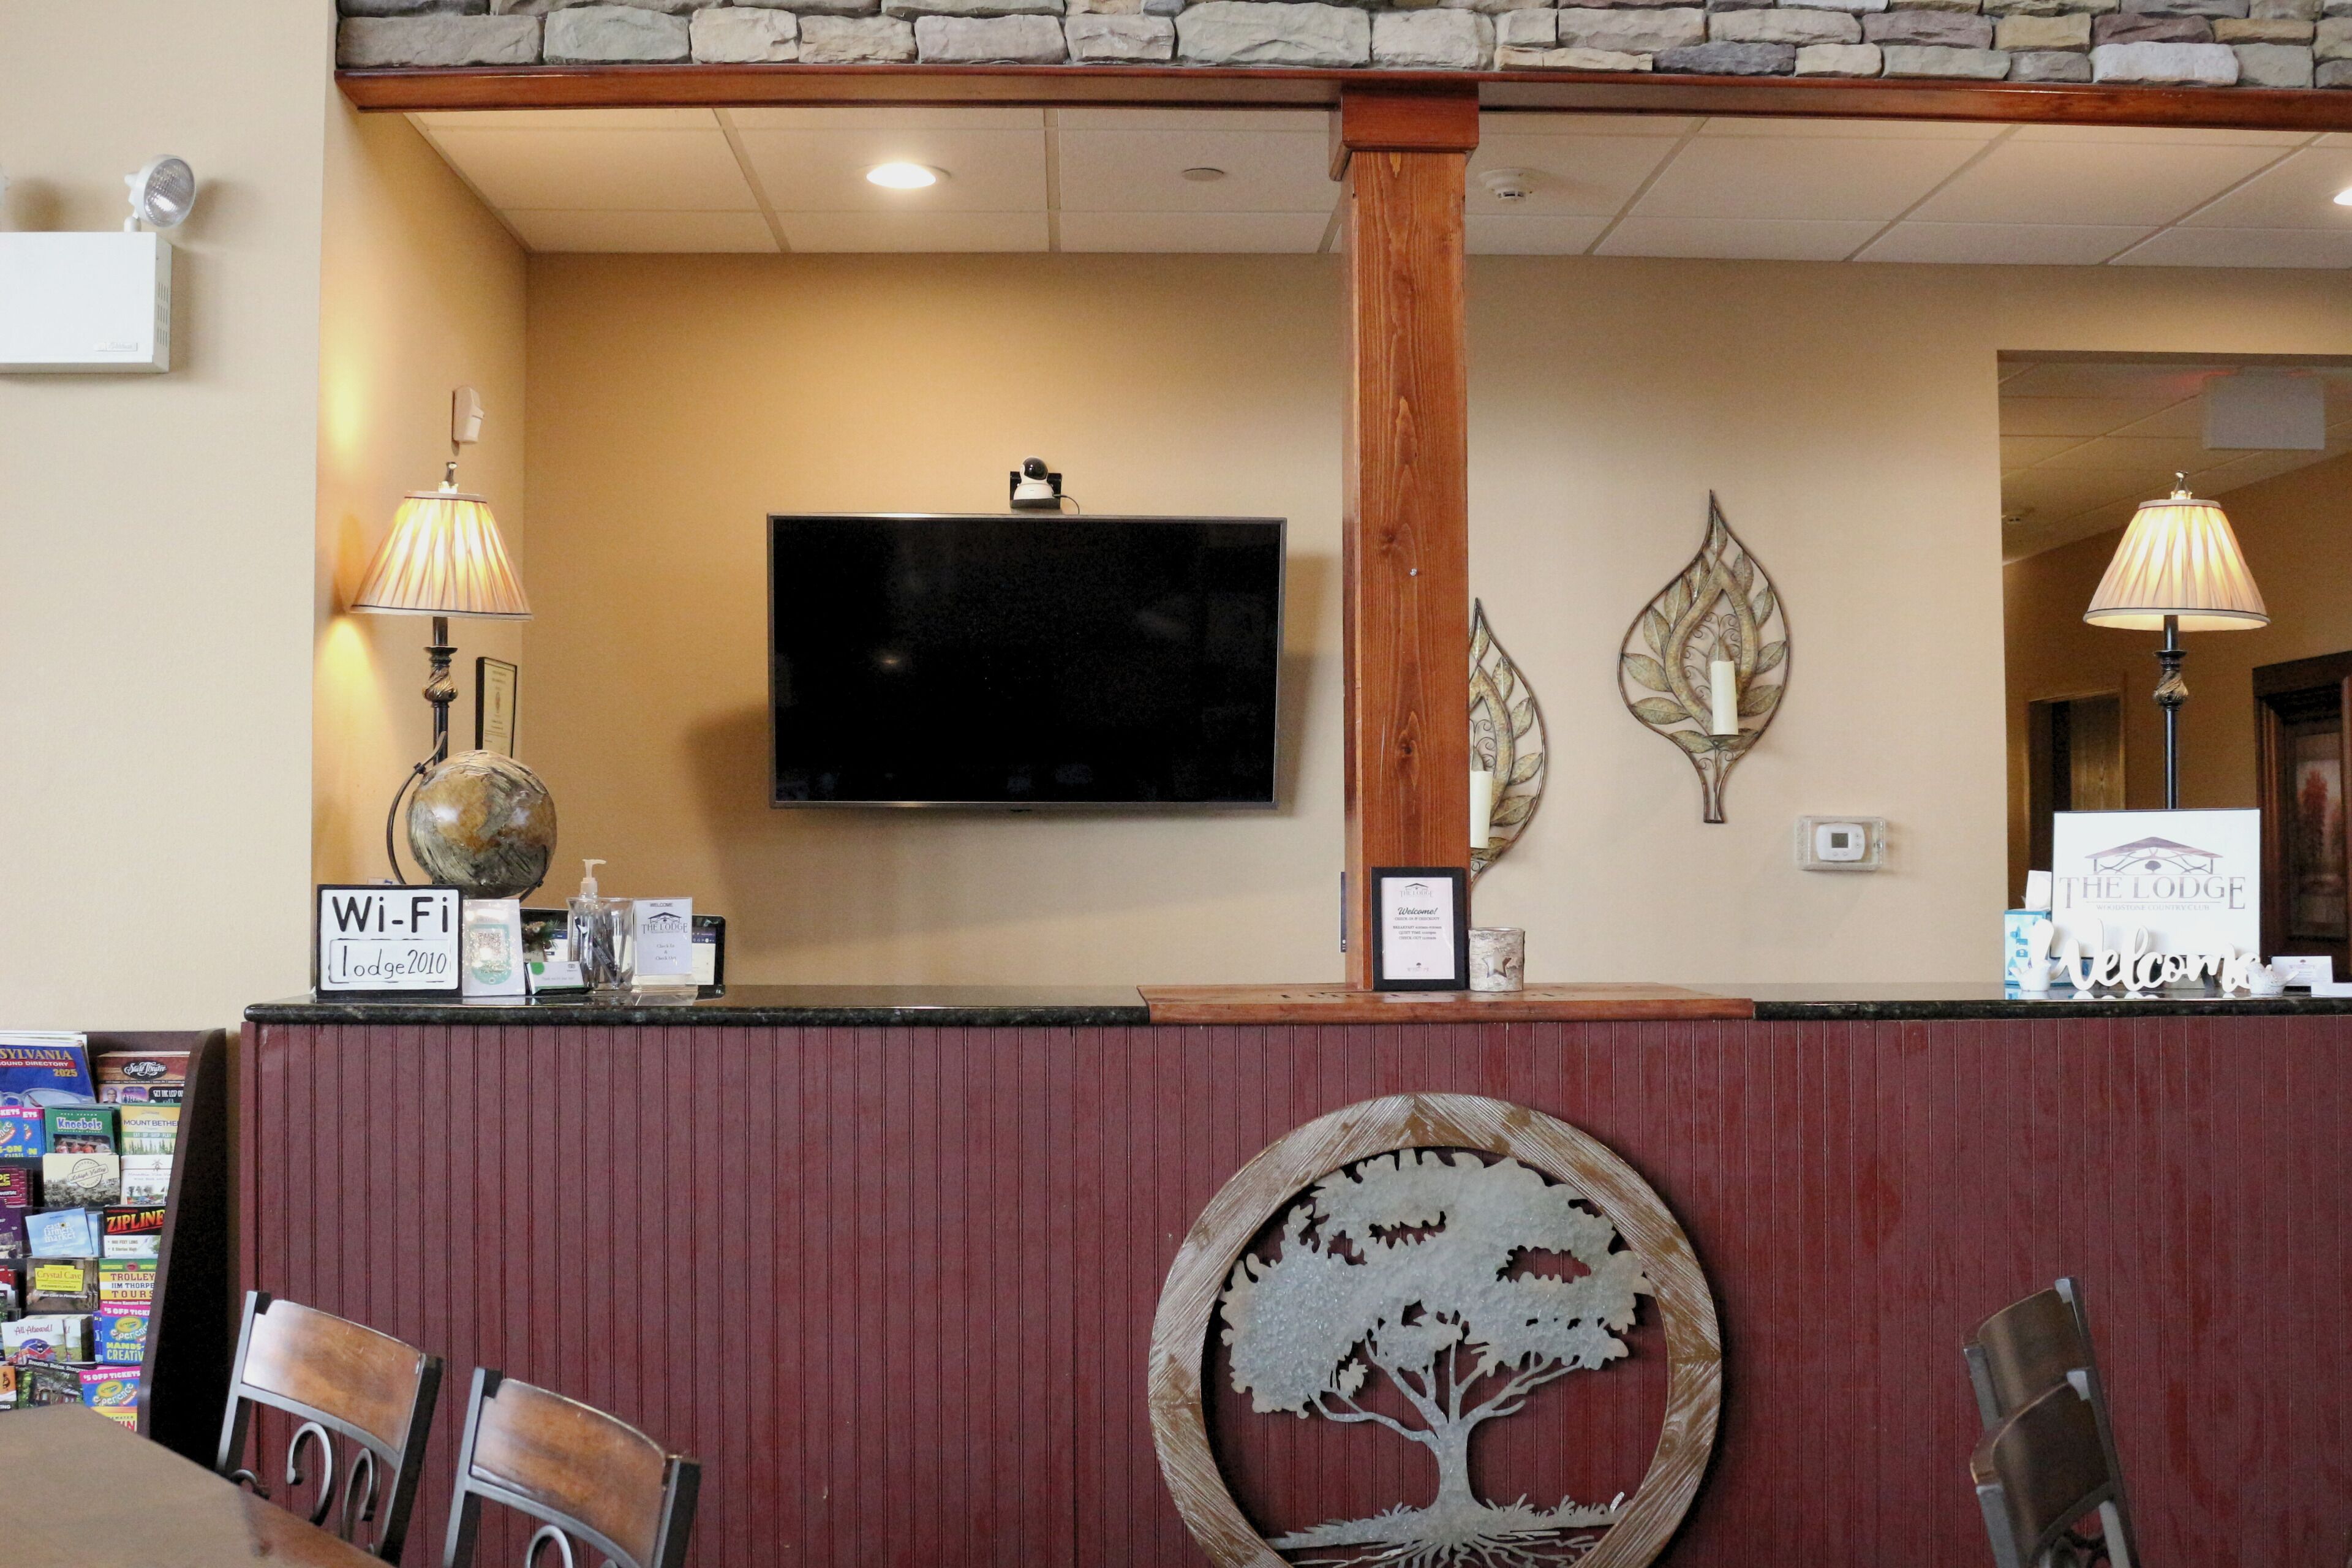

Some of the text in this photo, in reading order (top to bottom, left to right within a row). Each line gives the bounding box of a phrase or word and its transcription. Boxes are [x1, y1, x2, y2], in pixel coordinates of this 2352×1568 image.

[2059, 876, 2246, 910] THE LODGE
[331, 896, 448, 933] Wi-Fi
[1397, 907, 1439, 915] Welcome!
[641, 922, 688, 934] THE LODGE
[2032, 918, 2261, 992] Welcome
[53, 1069, 78, 1077] 2025
[138, 1061, 167, 1076] Theatre
[56, 1117, 102, 1131] Knoebels
[70, 1172, 89, 1181] Lehigh
[107, 1209, 165, 1233] ZIPLINE
[44, 1227, 74, 1236] farmers
[45, 1232, 75, 1243] market
[37, 1270, 81, 1280] Crystal Cave
[14, 1326, 24, 1336] All
[25, 1324, 53, 1335] Aboard!
[109, 1370, 141, 1379] TICKETS
